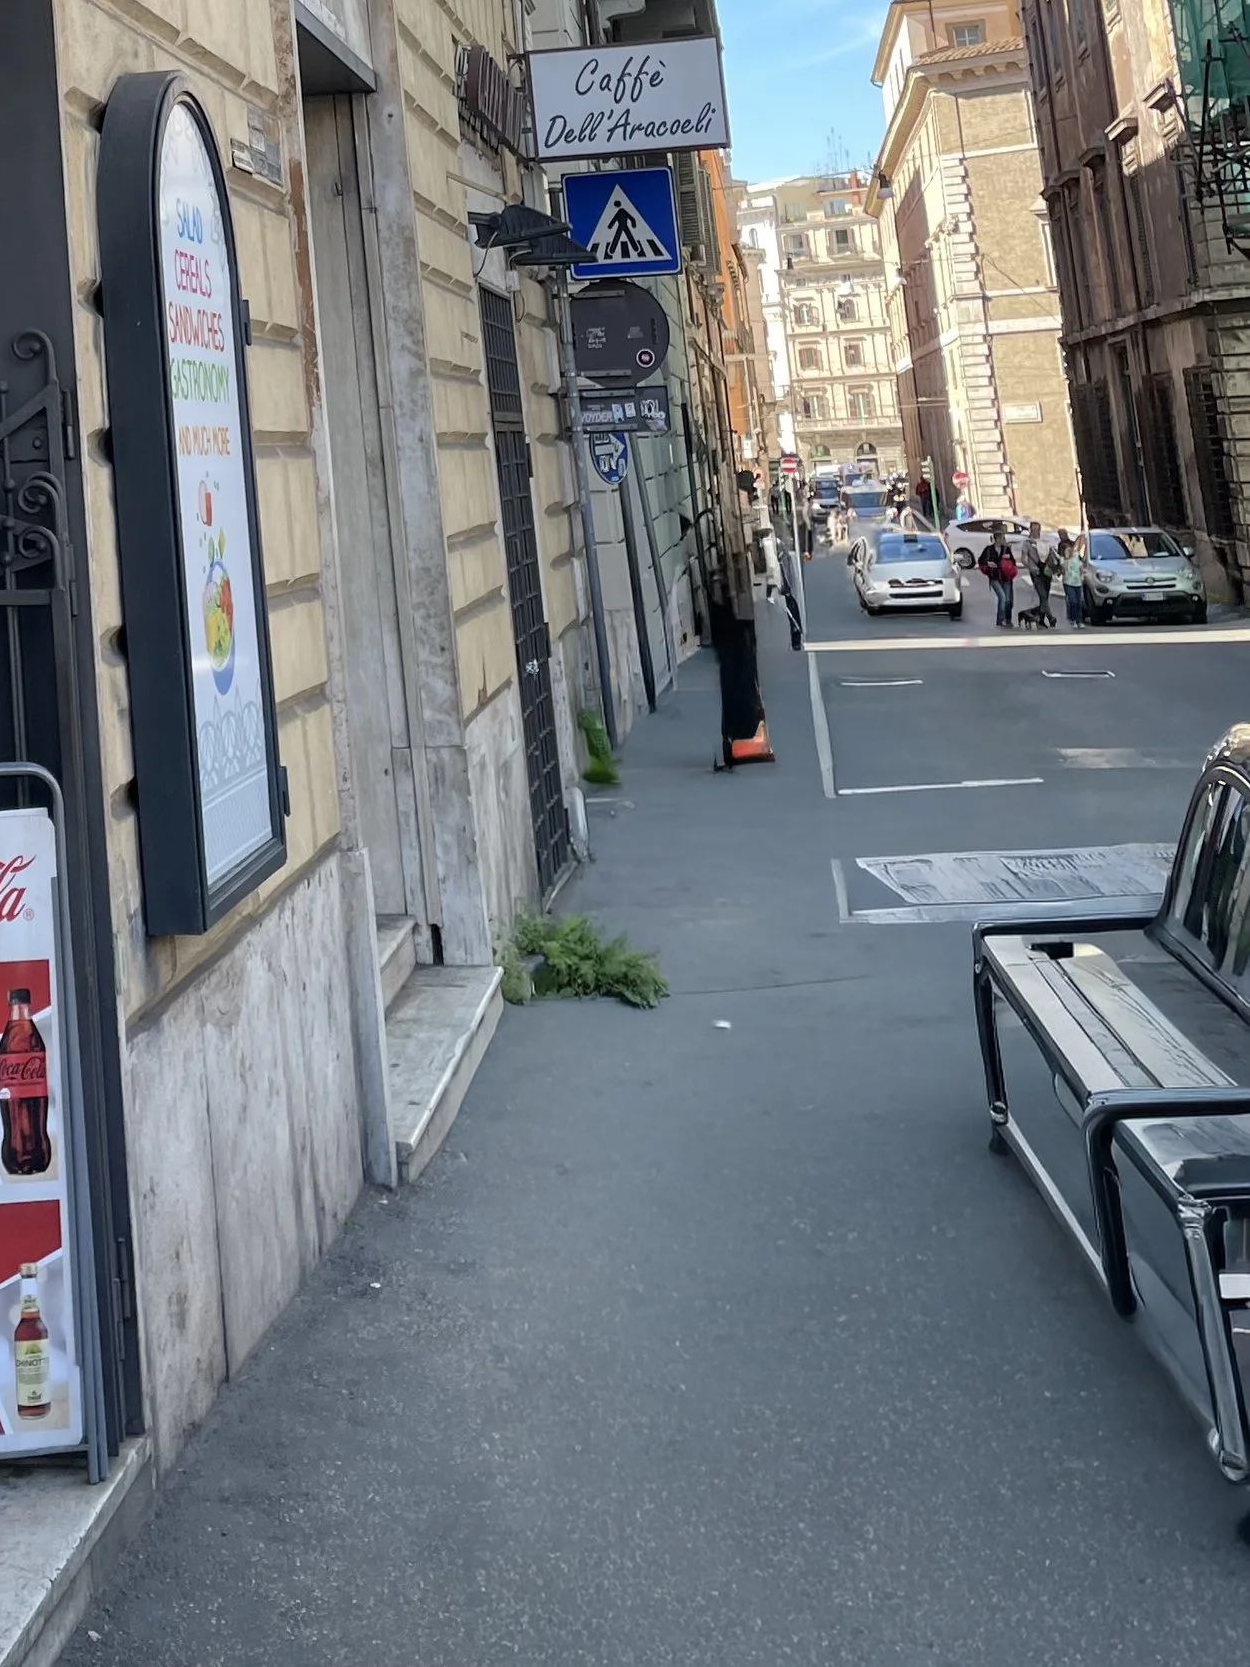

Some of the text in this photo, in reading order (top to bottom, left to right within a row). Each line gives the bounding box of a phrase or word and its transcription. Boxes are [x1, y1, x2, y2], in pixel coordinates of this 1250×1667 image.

[574, 55, 666, 104] Caffè
[544, 102, 717, 149] Dell'Aracoeli
[176, 197, 203, 245] SALAD
[174, 248, 212, 299] CEREALS
[168, 300, 226, 353] SANDWICHES
[170, 357, 231, 404] GASTRONOMY
[212, 426, 231, 456] MORE
